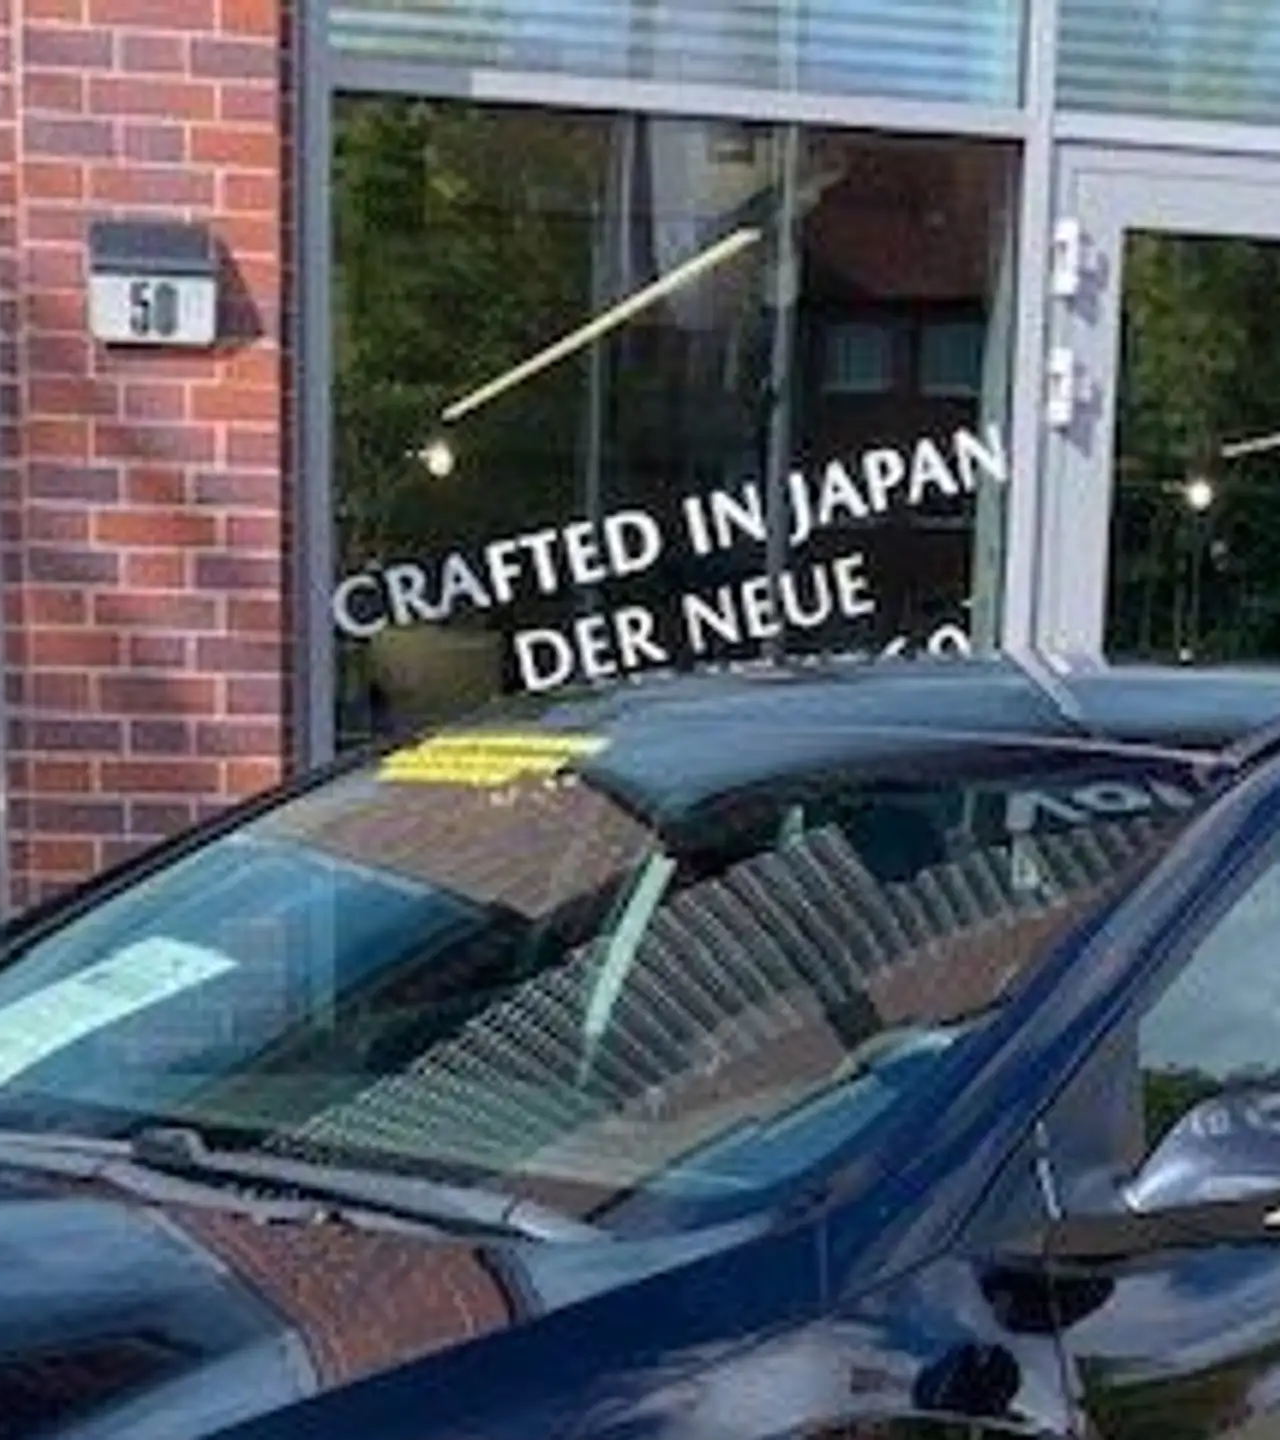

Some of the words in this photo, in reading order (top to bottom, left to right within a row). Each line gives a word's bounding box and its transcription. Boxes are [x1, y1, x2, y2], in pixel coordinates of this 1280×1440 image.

[331, 509, 662, 638] CRAFTED
[684, 488, 766, 556] IN
[786, 425, 1010, 546] JAPAN
[514, 612, 667, 694] DER
[686, 552, 877, 652] NEUE
